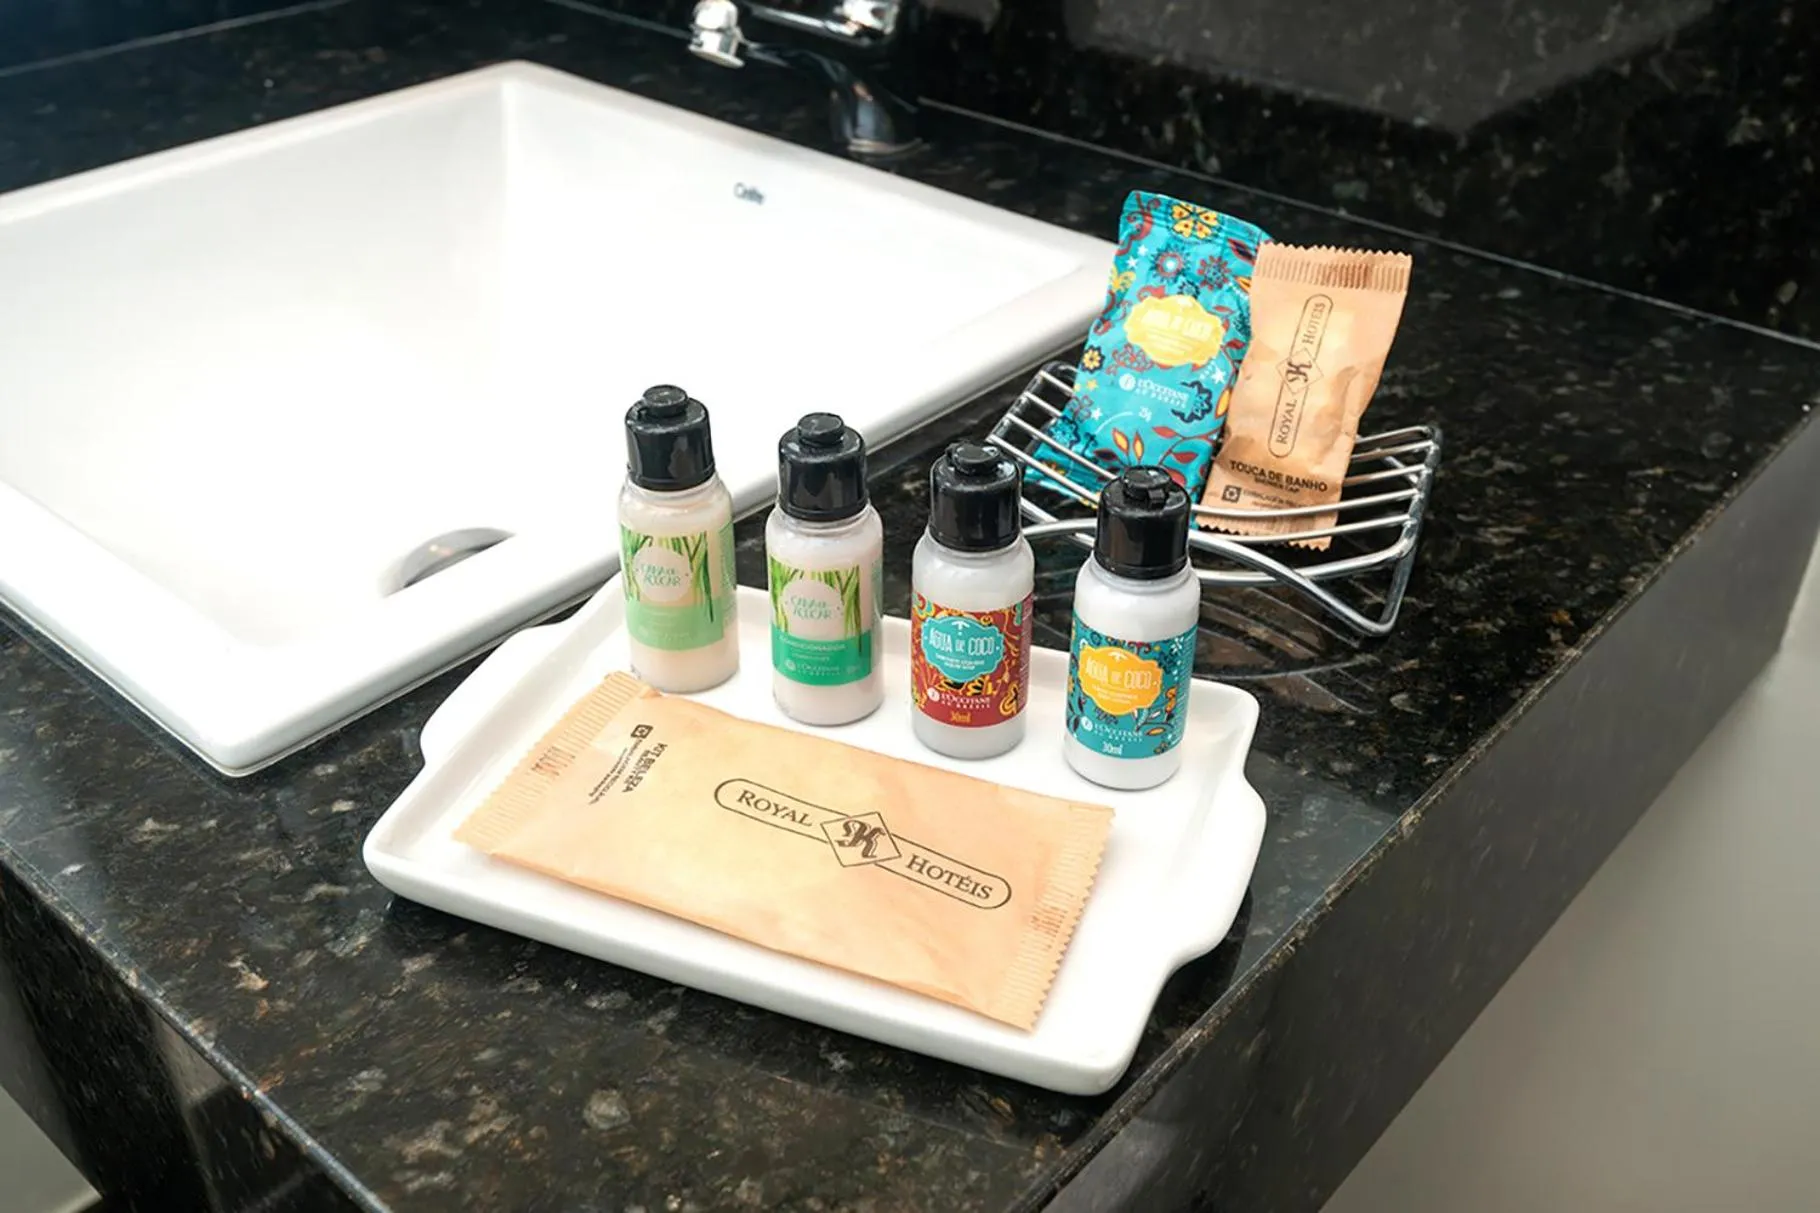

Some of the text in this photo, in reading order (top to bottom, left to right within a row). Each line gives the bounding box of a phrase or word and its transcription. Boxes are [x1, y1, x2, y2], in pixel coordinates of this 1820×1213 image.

[1275, 397, 1298, 446] ROYAL
[1229, 460, 1328, 493] TOUCA DE BANHO
[968, 636, 995, 657] COCO
[737, 789, 813, 827] ROYAL
[905, 853, 993, 900] HOTÉIS
